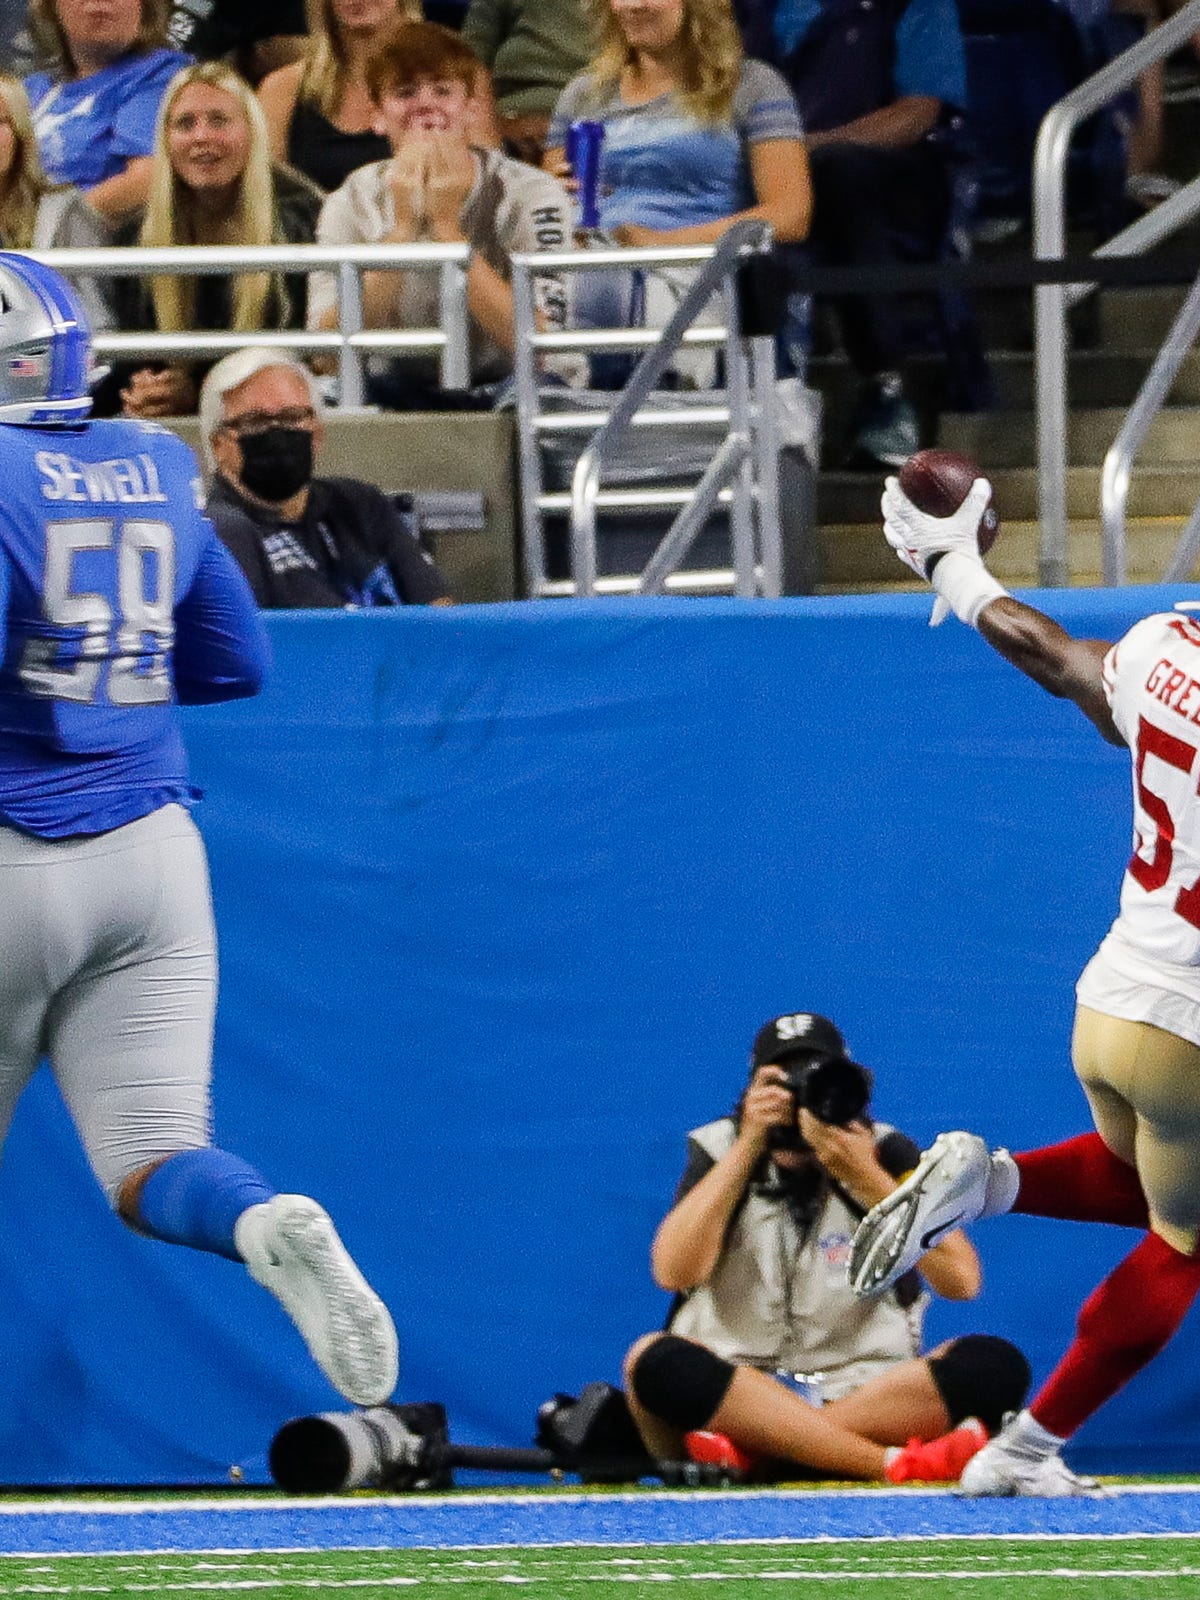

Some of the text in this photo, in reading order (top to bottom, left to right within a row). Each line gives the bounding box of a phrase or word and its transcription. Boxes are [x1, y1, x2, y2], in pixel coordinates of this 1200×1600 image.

[35, 450, 167, 501] SEWELL
[20, 516, 175, 706] 58
[776, 1014, 812, 1040] SF
